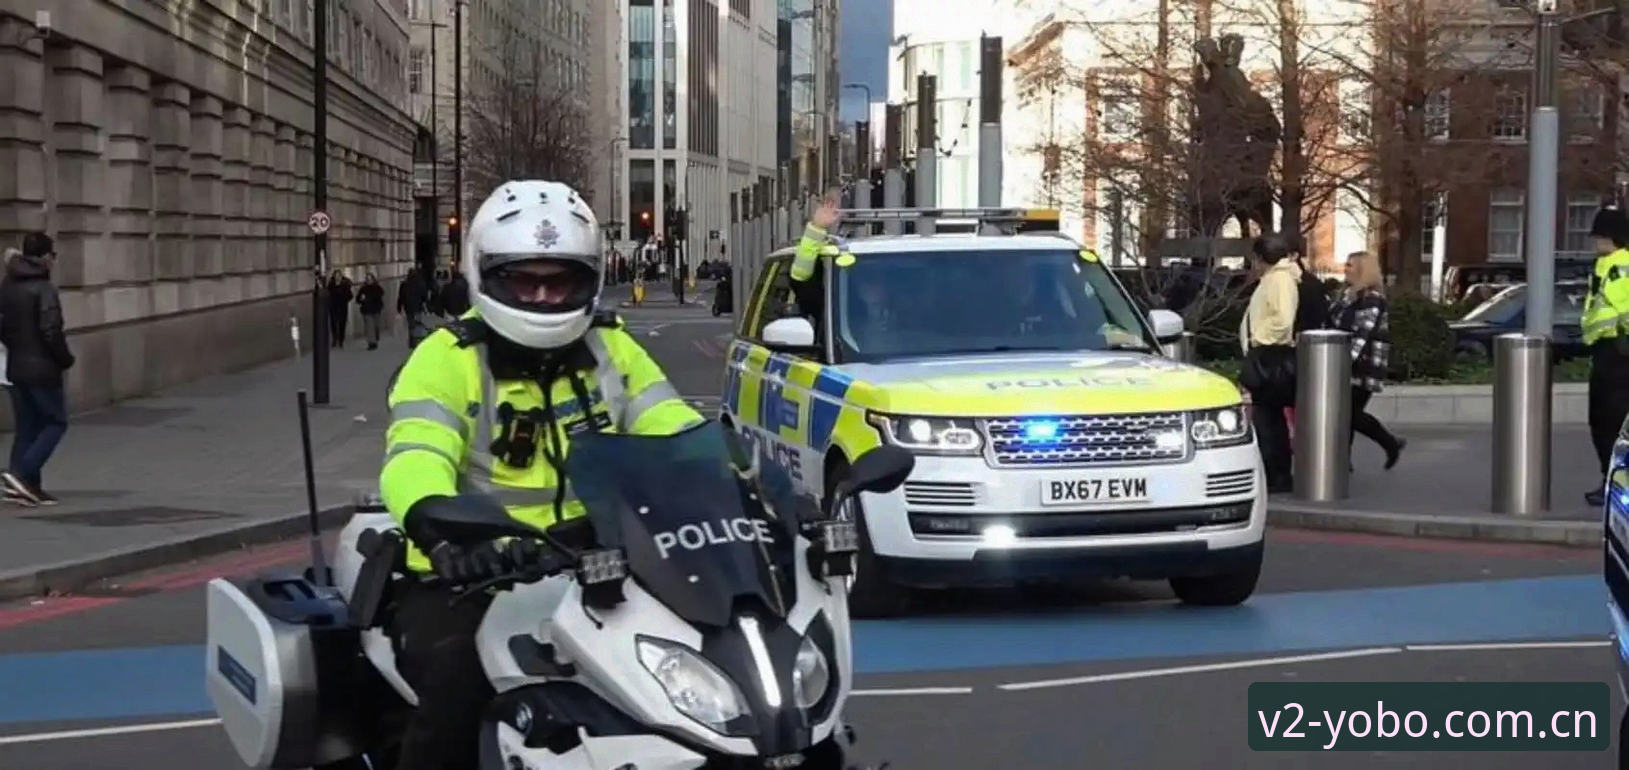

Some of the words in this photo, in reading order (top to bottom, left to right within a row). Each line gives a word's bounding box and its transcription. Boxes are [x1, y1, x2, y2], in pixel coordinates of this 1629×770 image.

[310, 216, 329, 229] 20
[986, 376, 1153, 391] POLICE
[1050, 480, 1103, 500] BX67
[1108, 478, 1147, 498] EVM
[653, 517, 775, 559] POLICE
